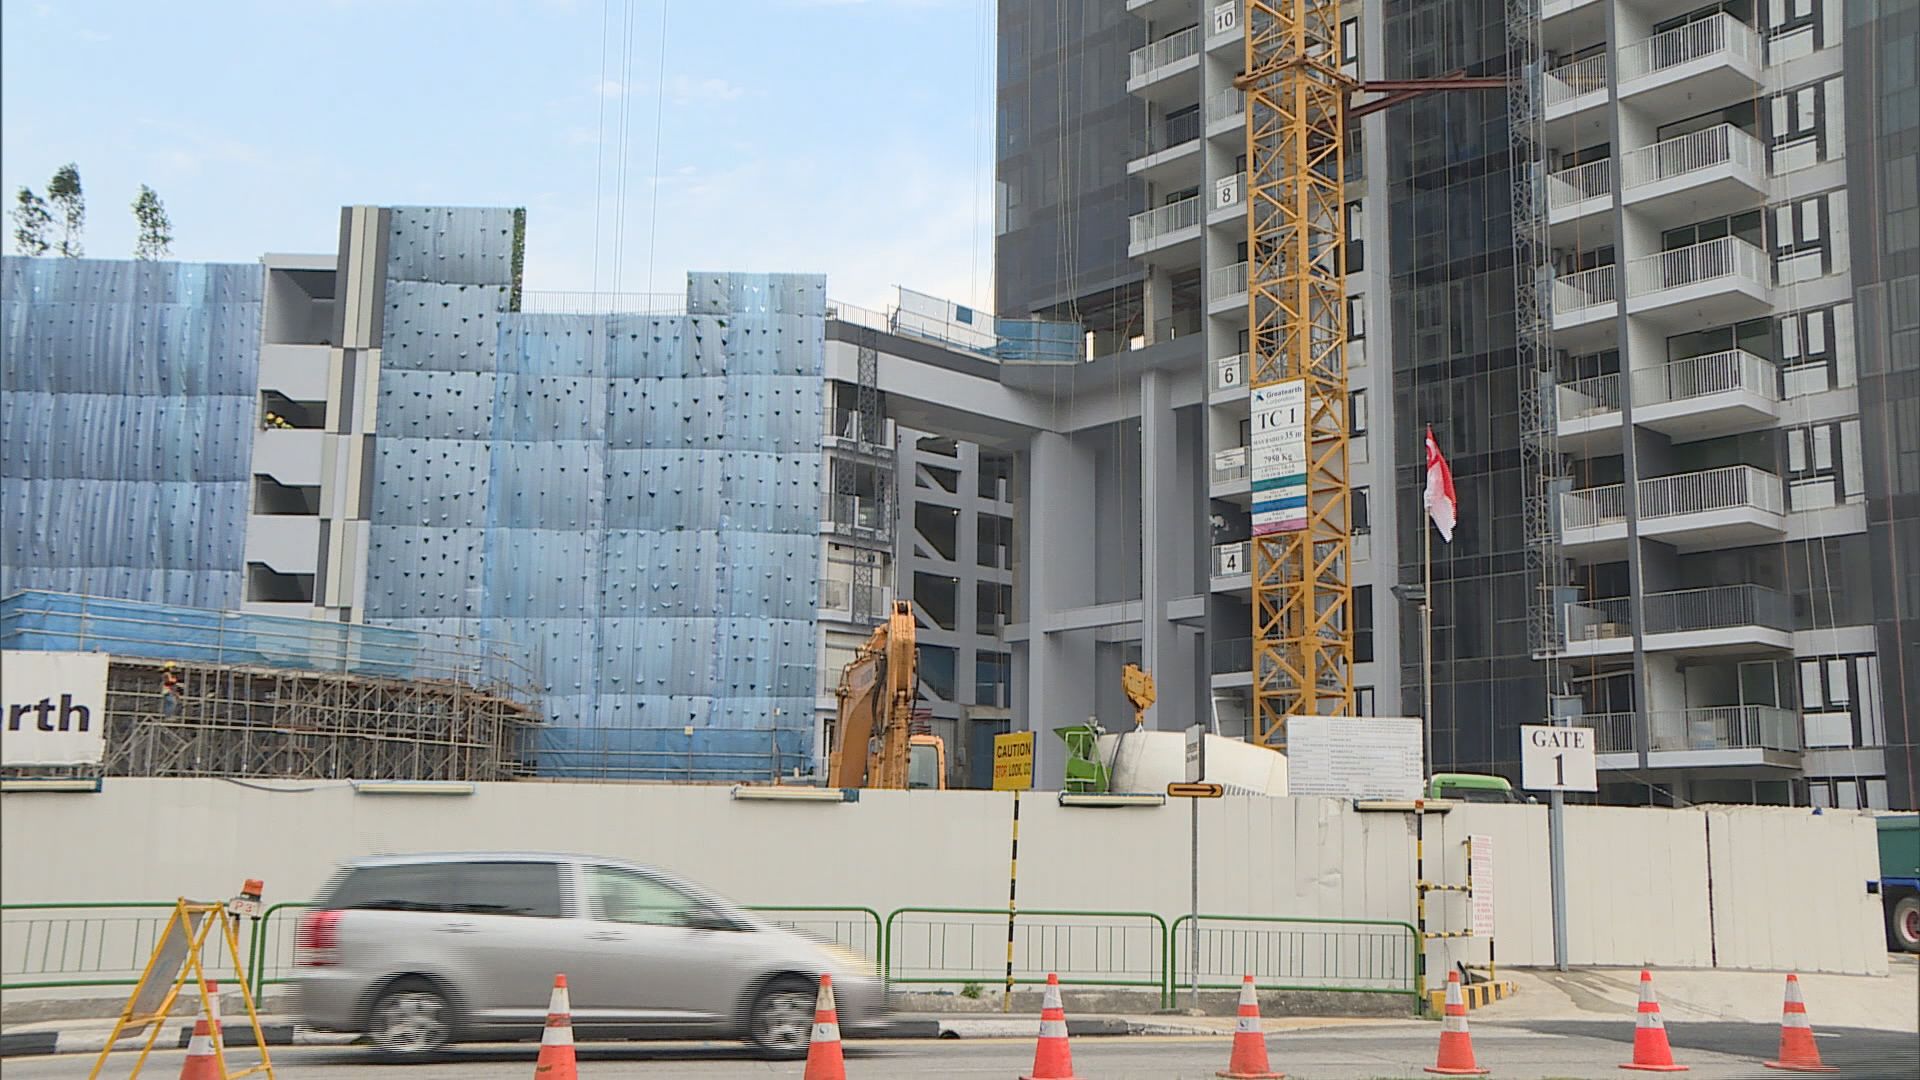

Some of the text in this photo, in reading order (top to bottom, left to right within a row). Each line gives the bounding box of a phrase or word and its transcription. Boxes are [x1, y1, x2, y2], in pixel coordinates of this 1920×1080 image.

[1216, 11, 1233, 30] 10
[1222, 187, 1231, 204] 8
[1225, 367, 1234, 384] 6
[1266, 386, 1302, 399] Greatearth
[1257, 409, 1282, 430] TC
[1227, 554, 1236, 571] 4
[1, 693, 90, 732] rth
[1532, 730, 1585, 749] GATE
[997, 741, 1031, 758] CAUTION
[1552, 753, 1566, 786] 1
